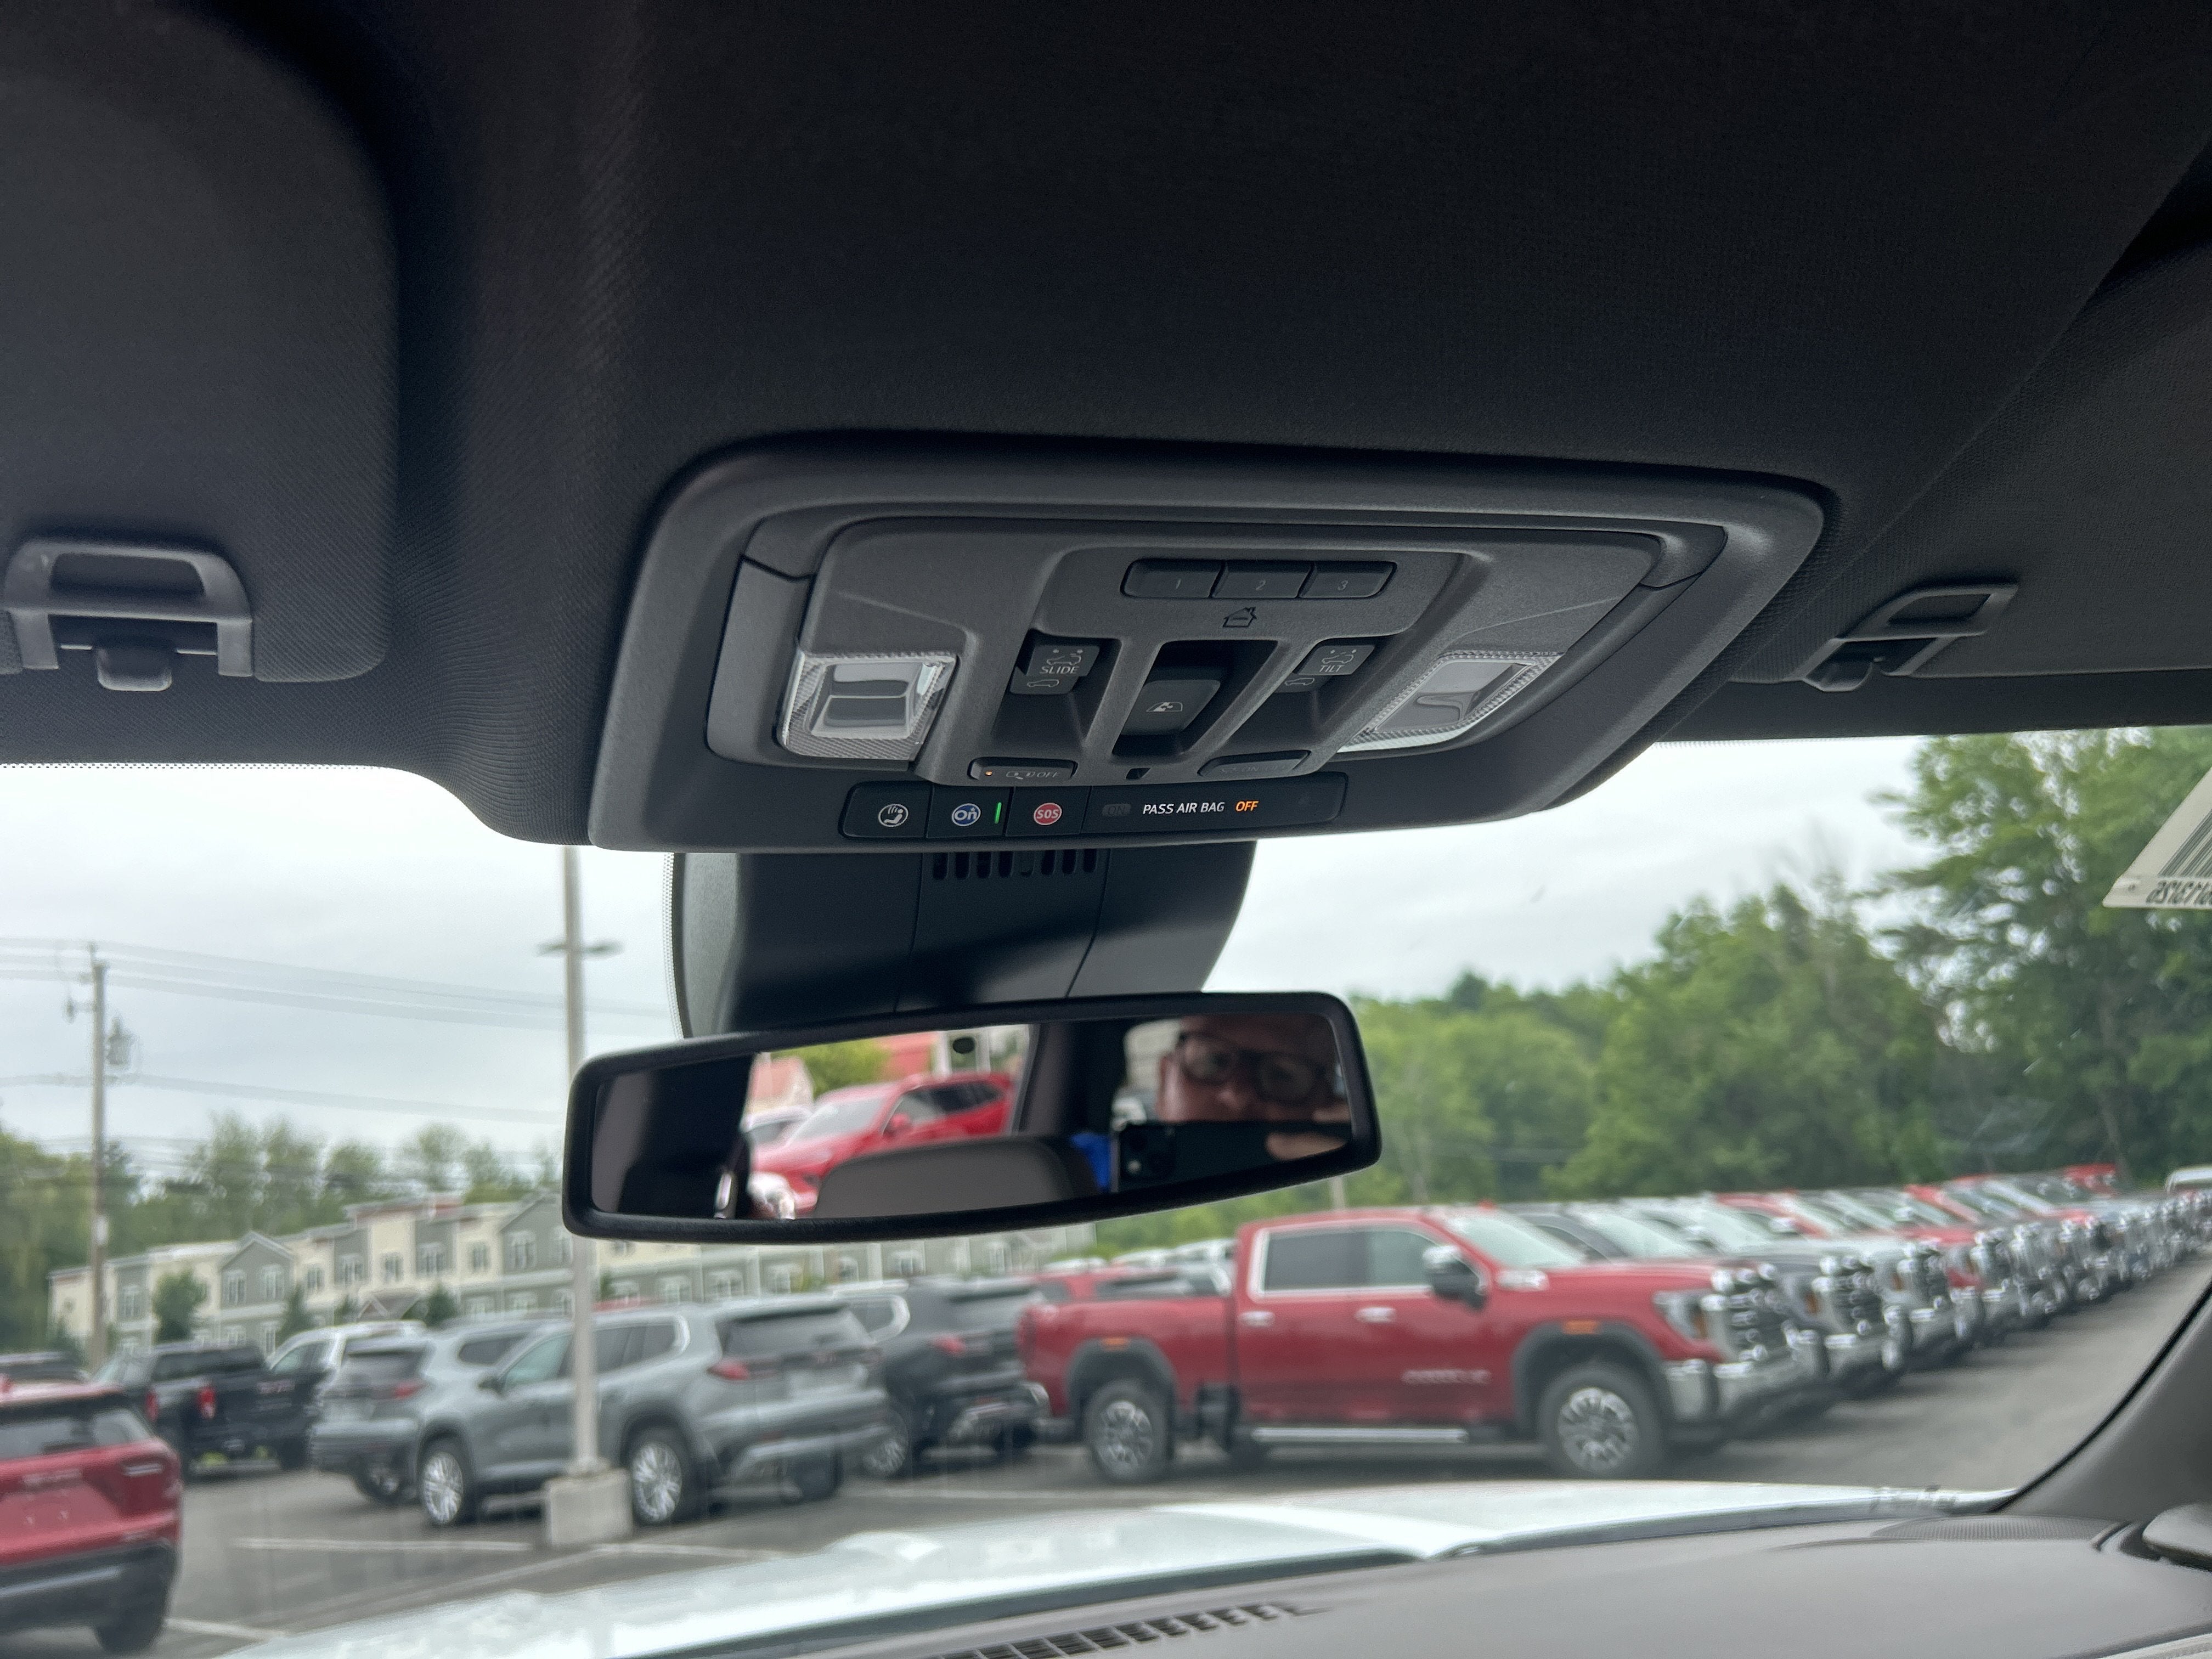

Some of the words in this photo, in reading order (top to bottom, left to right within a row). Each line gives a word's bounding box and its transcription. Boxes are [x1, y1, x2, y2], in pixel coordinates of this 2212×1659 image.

[1175, 578, 1182, 590] 1
[1255, 579, 1266, 591] 2
[1337, 580, 1349, 591] 3
[1039, 665, 1080, 674] SLIDE
[1319, 664, 1345, 673] TILT
[1142, 803, 1174, 815] PASS
[1176, 803, 1198, 814] AIR
[1200, 802, 1225, 813] BAG
[1235, 800, 1260, 812] OFF
[1036, 808, 1060, 820] SOS
